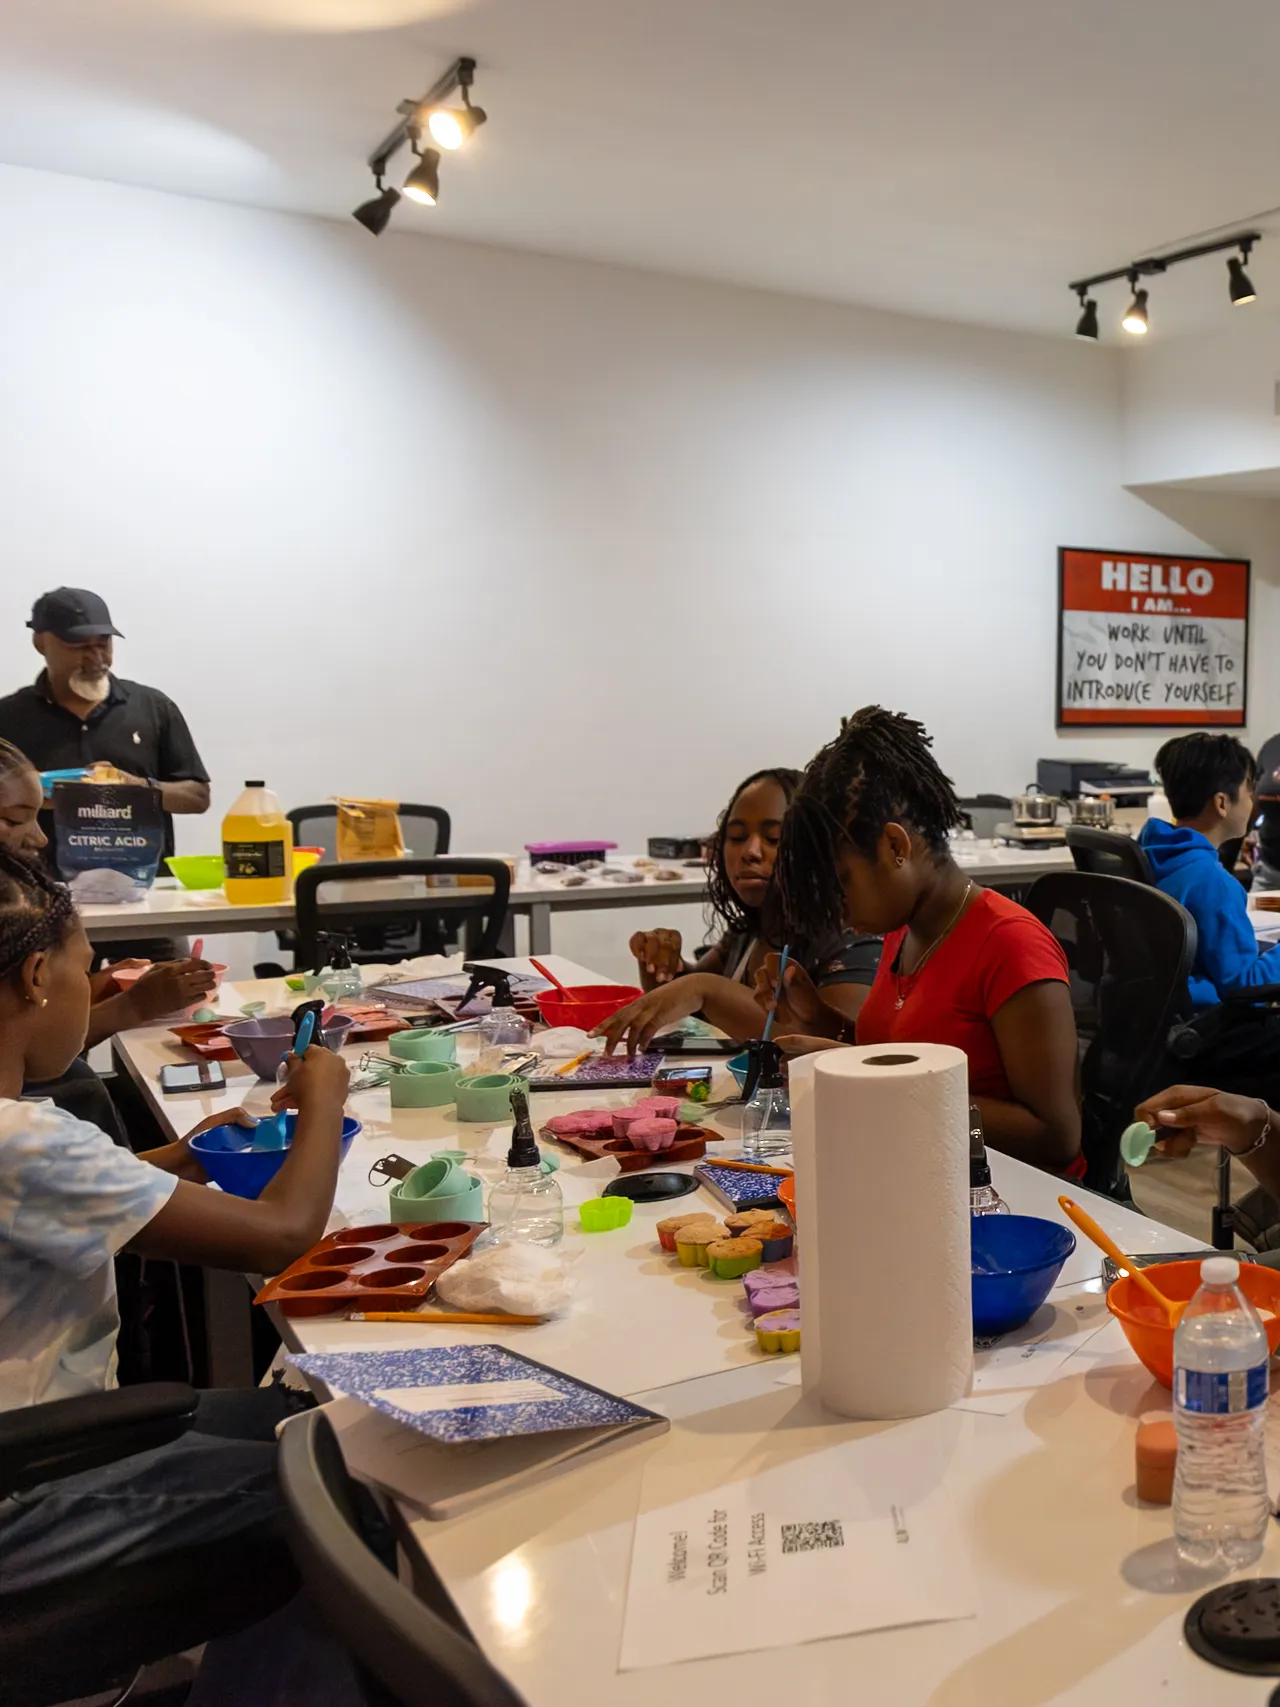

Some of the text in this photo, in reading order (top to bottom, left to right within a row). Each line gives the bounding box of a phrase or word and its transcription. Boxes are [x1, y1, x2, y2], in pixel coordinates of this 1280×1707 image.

[1101, 560, 1214, 596] HELLO
[1131, 596, 1138, 611] I
[1108, 622, 1208, 645] WORK UNTIL
[1076, 649, 1235, 674] YOU DON'T HAVE TO
[1066, 679, 1236, 706] INTRODUCE YOURSELF
[77, 803, 133, 819] milliard
[68, 835, 148, 847] CITRIC ACID
[666, 1530, 688, 1583] Welcome!
[706, 1509, 729, 1595] Scan QR Code for
[747, 1512, 766, 1578] Wi-Fi Access
